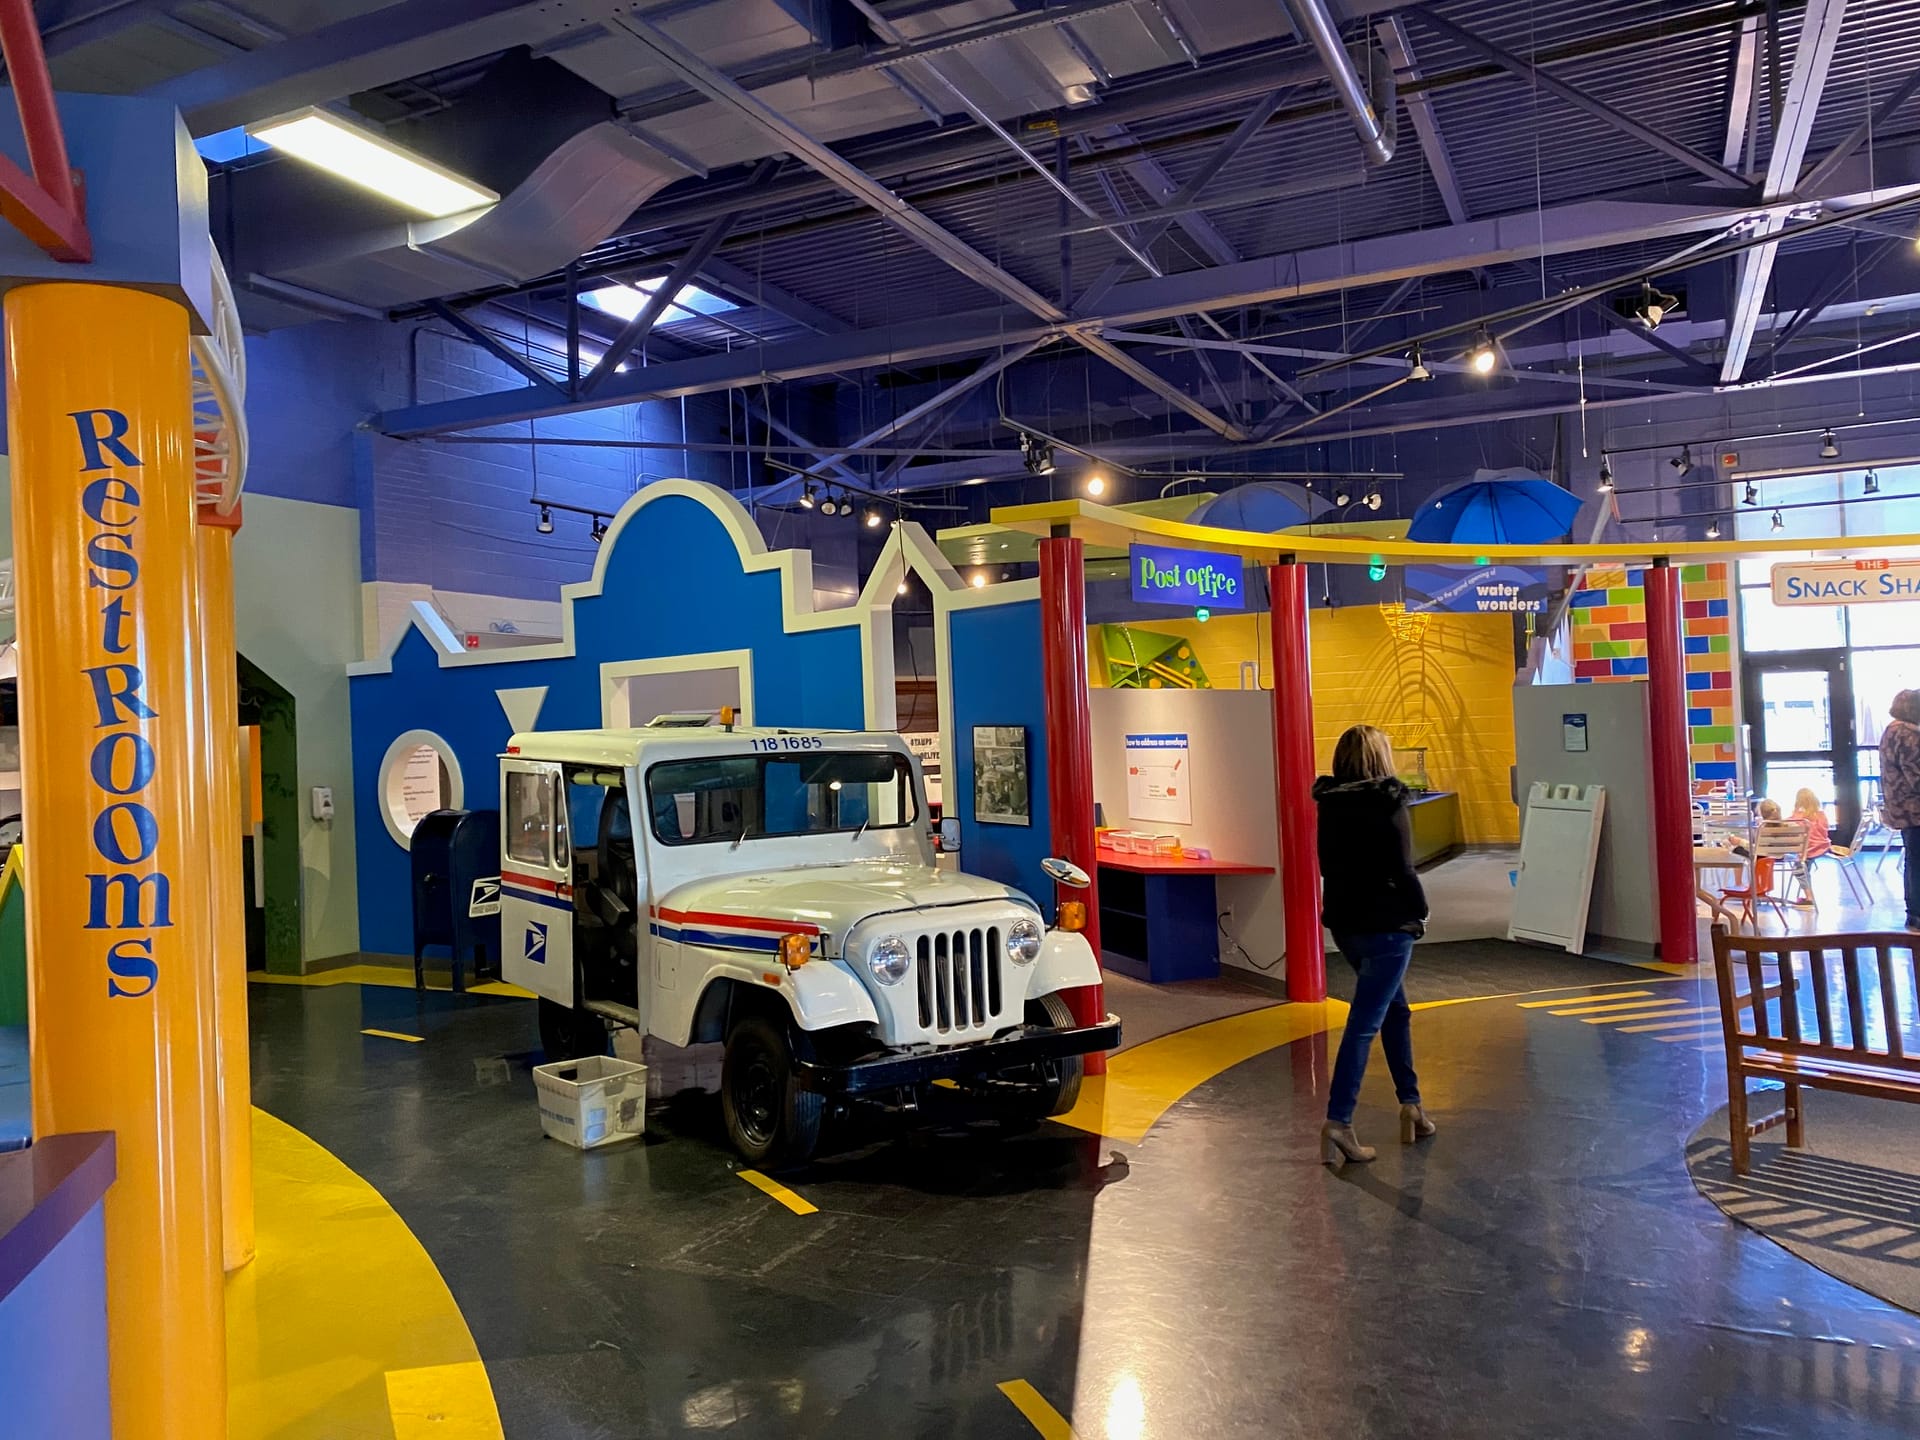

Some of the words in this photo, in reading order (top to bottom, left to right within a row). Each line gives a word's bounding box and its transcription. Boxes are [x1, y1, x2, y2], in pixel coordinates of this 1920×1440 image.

[1861, 560, 1884, 569] THE
[1140, 556, 1181, 589] Post
[1185, 564, 1237, 598] office
[1476, 583, 1520, 597] water
[1476, 596, 1541, 611] wonders
[911, 738, 933, 746] STAMPS
